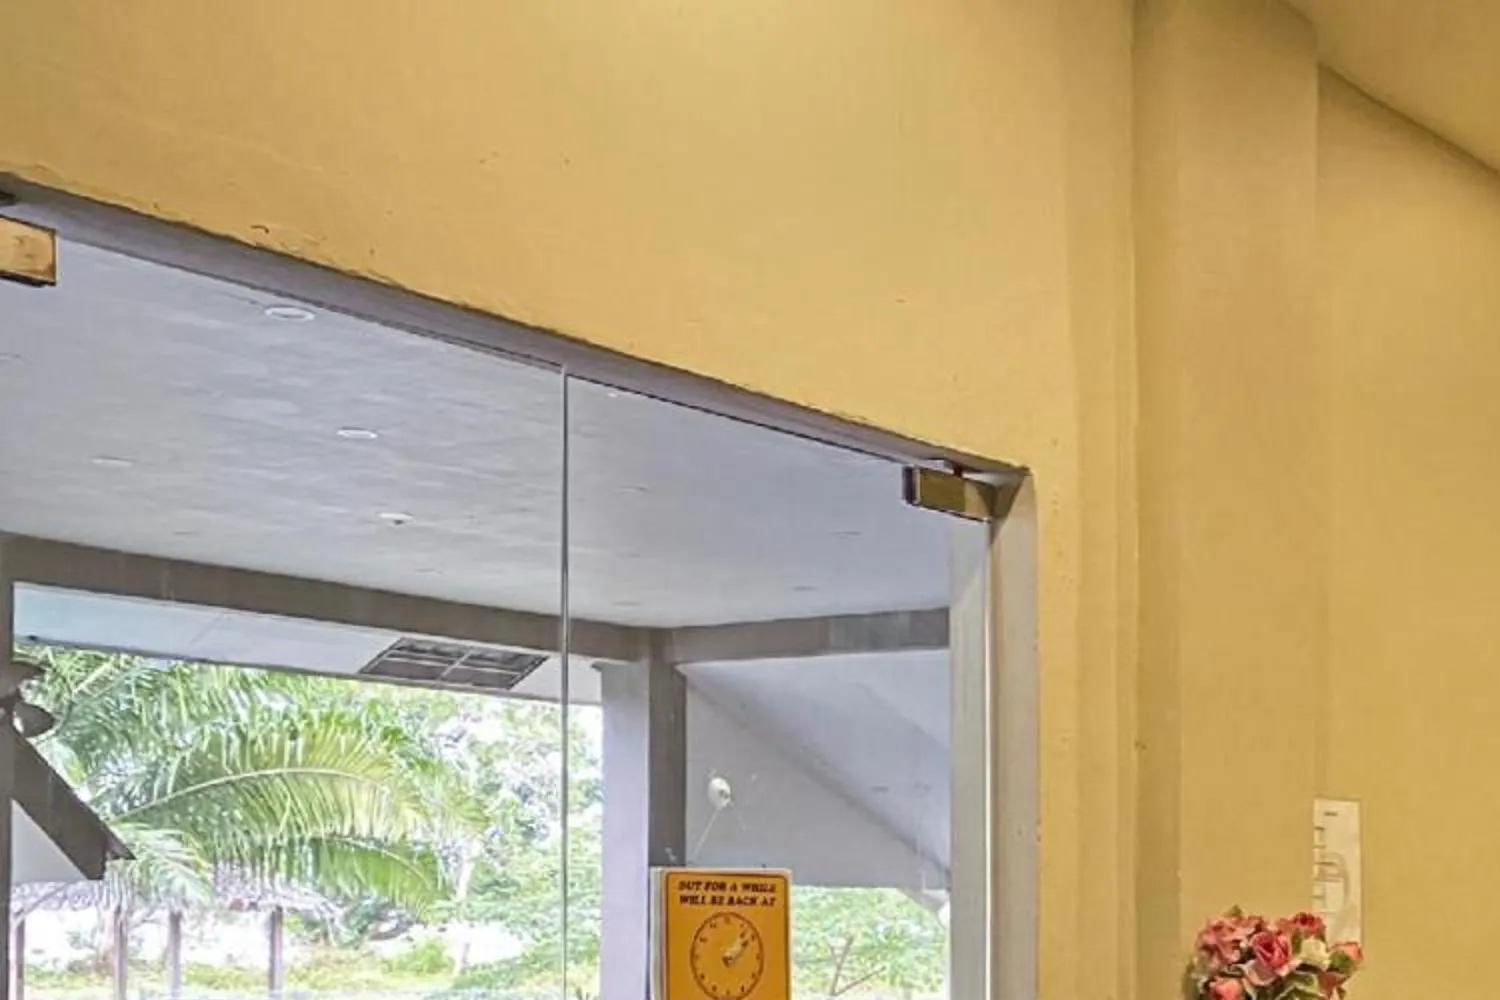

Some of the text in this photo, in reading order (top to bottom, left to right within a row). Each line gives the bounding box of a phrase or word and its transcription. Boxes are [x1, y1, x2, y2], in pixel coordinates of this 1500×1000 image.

[679, 880, 776, 893] OUT FOR A WHILE
[680, 895, 706, 905] WILL
[727, 896, 758, 906] BACK
